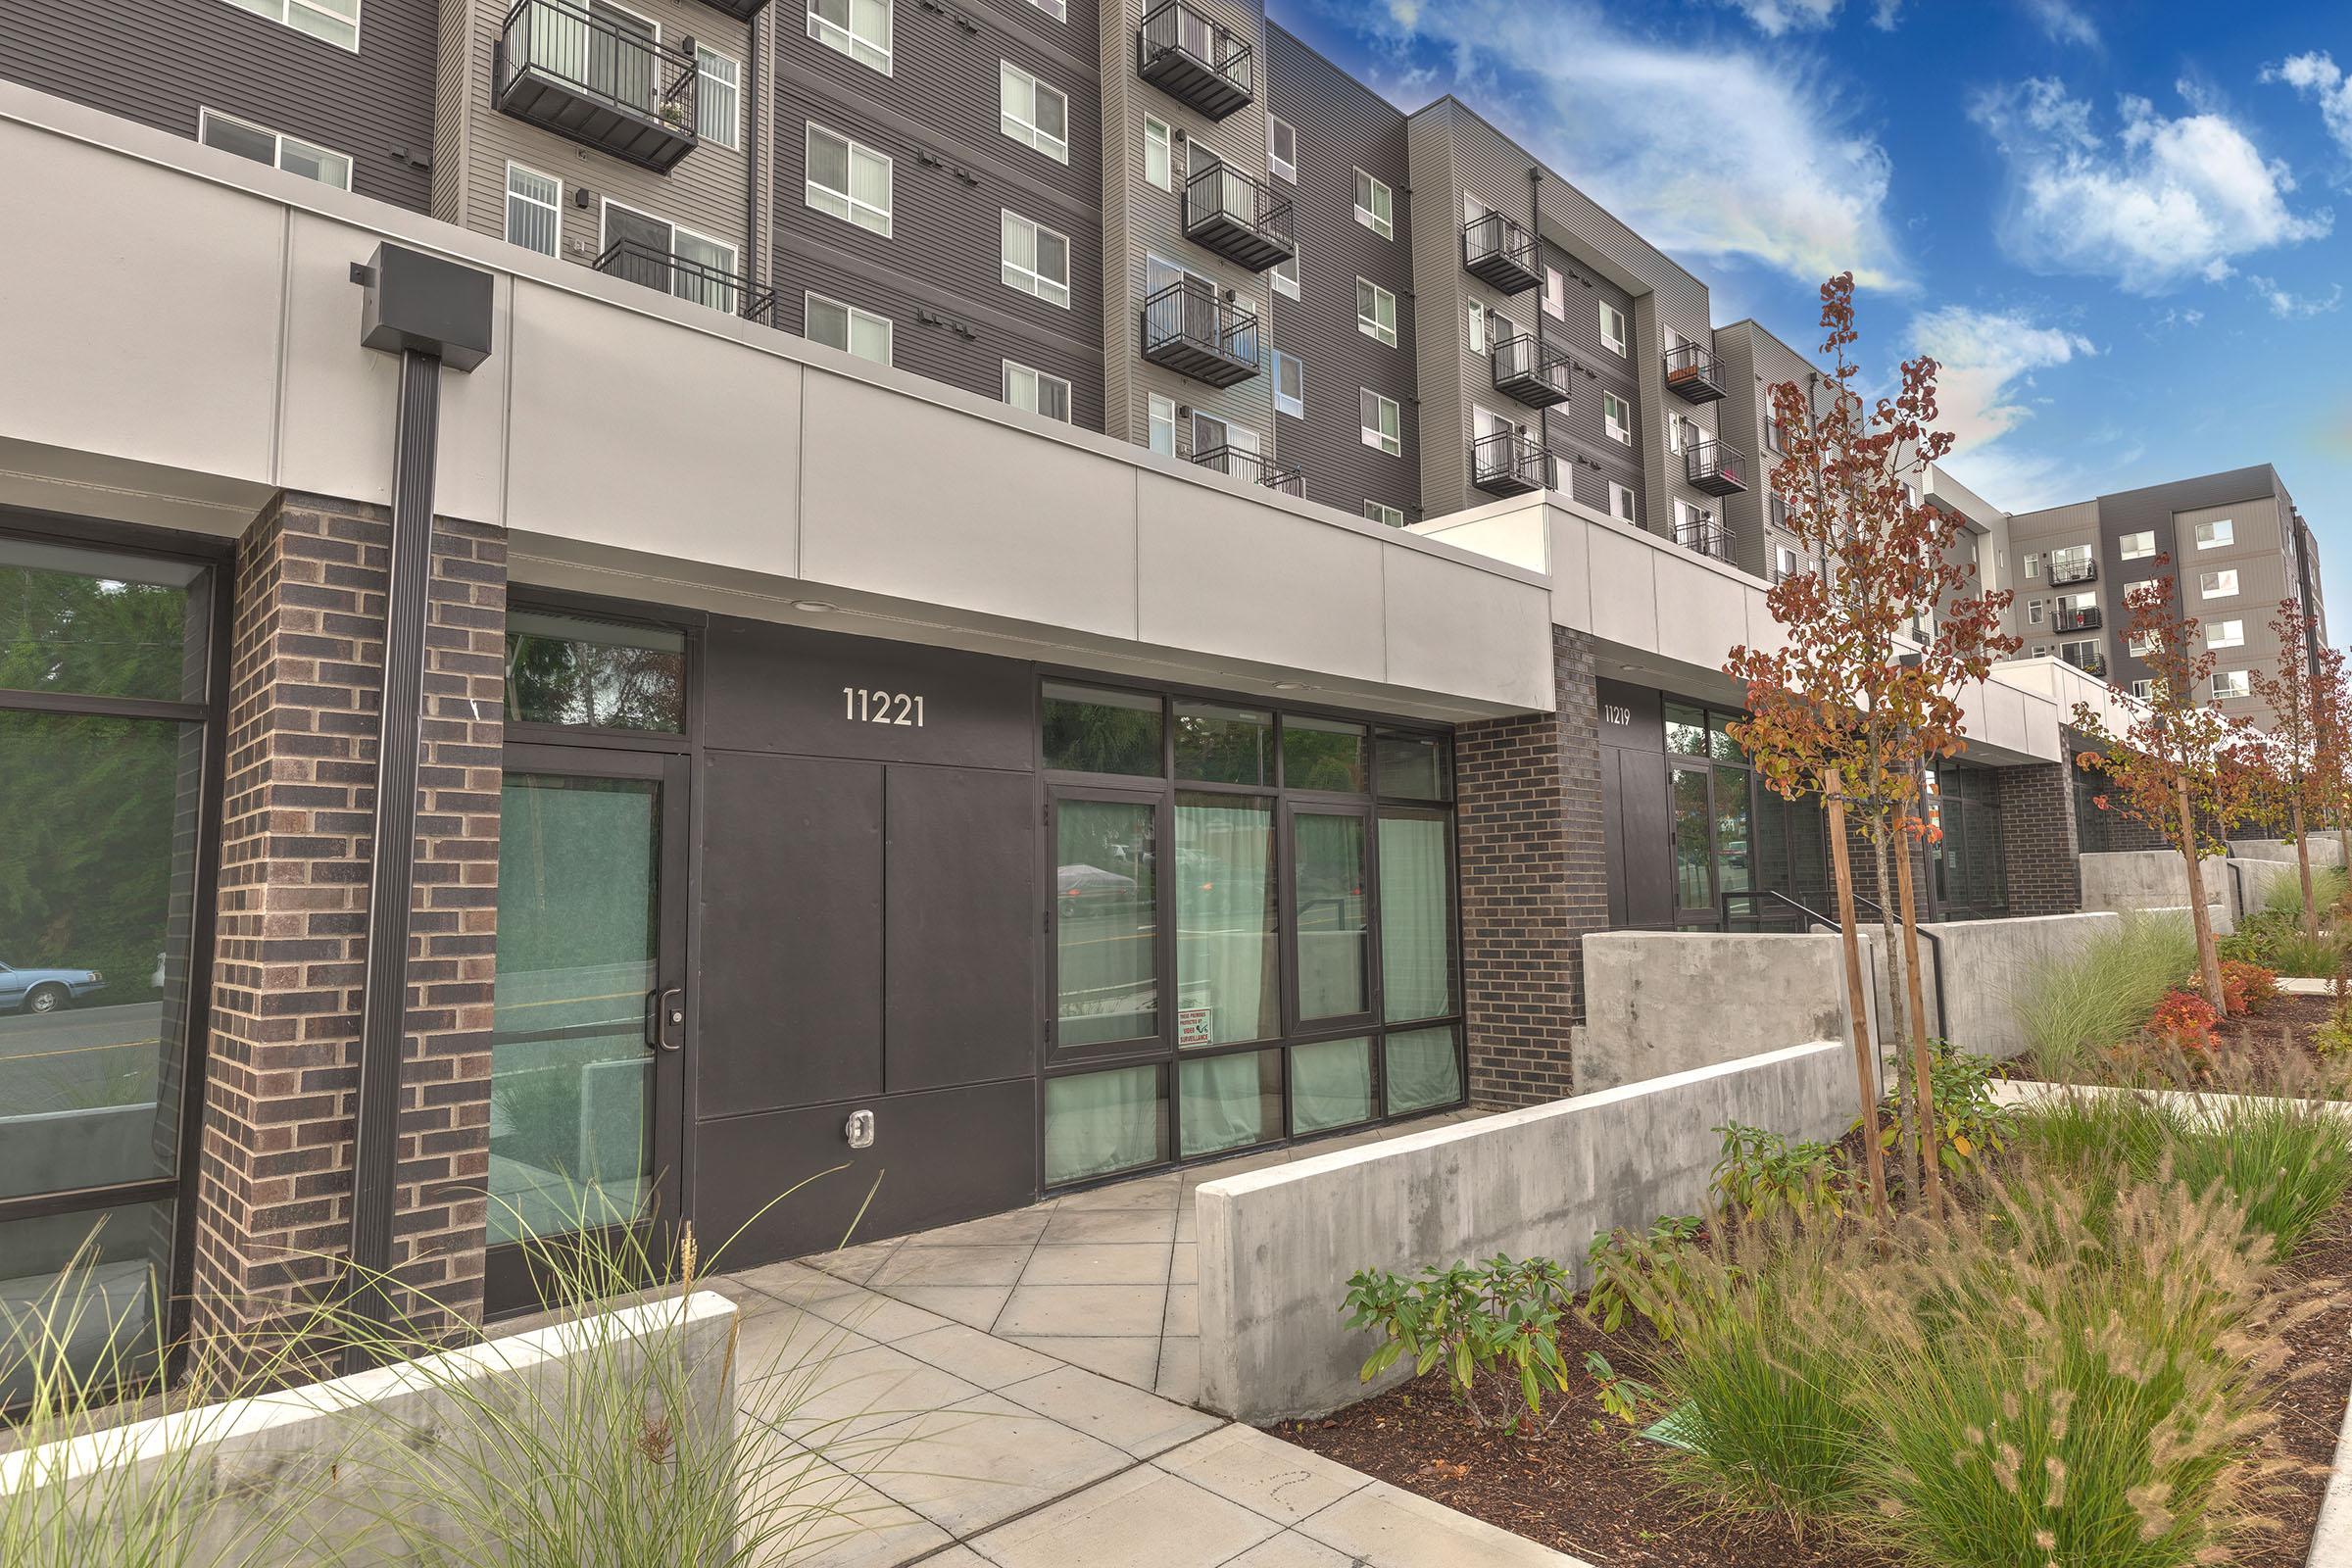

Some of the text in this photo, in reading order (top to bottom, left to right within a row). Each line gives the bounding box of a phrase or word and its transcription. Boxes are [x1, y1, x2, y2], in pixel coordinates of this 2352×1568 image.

[843, 687, 924, 727] 11221
[1604, 704, 1631, 725] 11219
[1180, 1034, 1207, 1043] SURVEILLANCE
